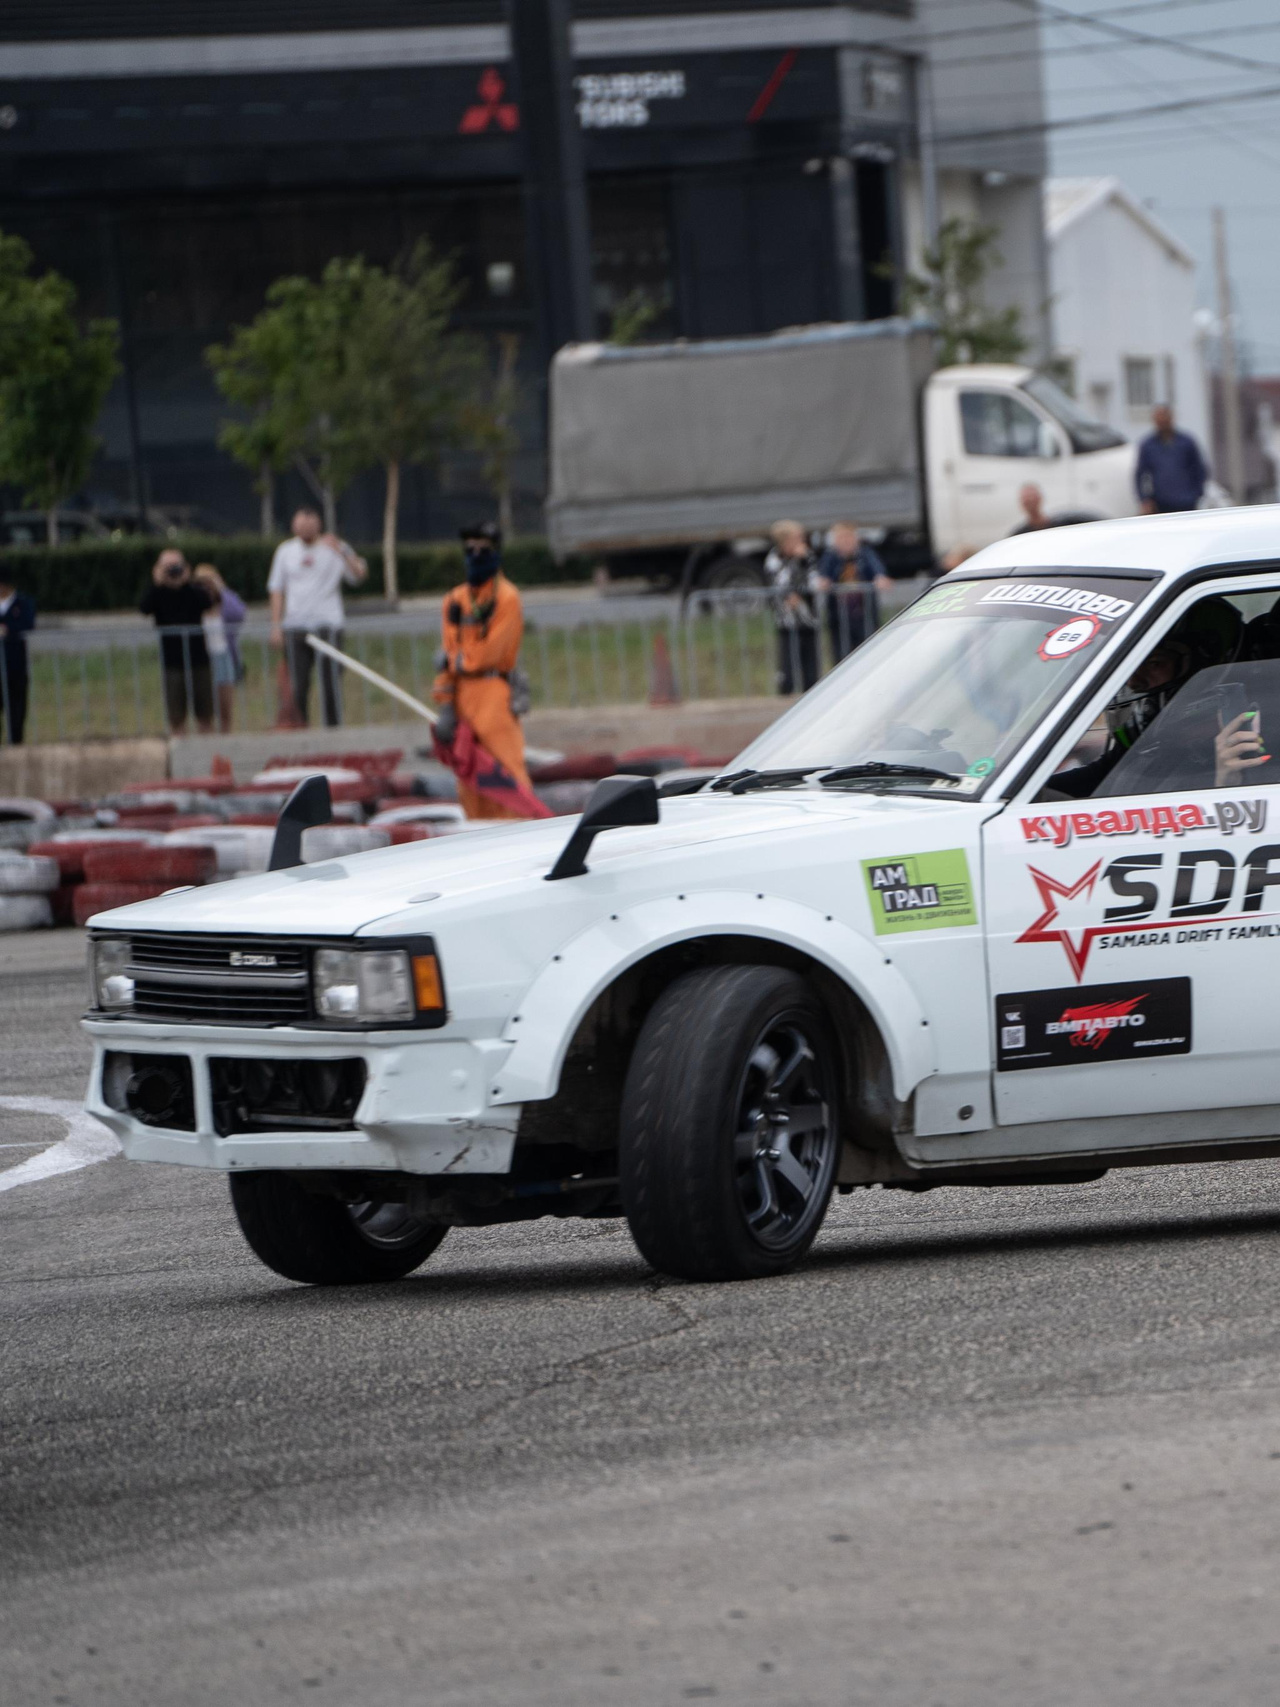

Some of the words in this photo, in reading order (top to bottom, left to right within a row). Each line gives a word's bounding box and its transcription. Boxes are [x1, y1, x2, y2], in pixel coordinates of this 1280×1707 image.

[980, 584, 1135, 618] CLUBTURBO
[1057, 633, 1082, 643] 88
[1019, 799, 1268, 848] кувалда.ру
[873, 866, 907, 888] АМ
[883, 886, 939, 910] ГРАД
[1099, 932, 1171, 950] SAMARA
[1176, 928, 1223, 945] DRIFT
[1045, 1014, 1146, 1035] ВМПАВТО
